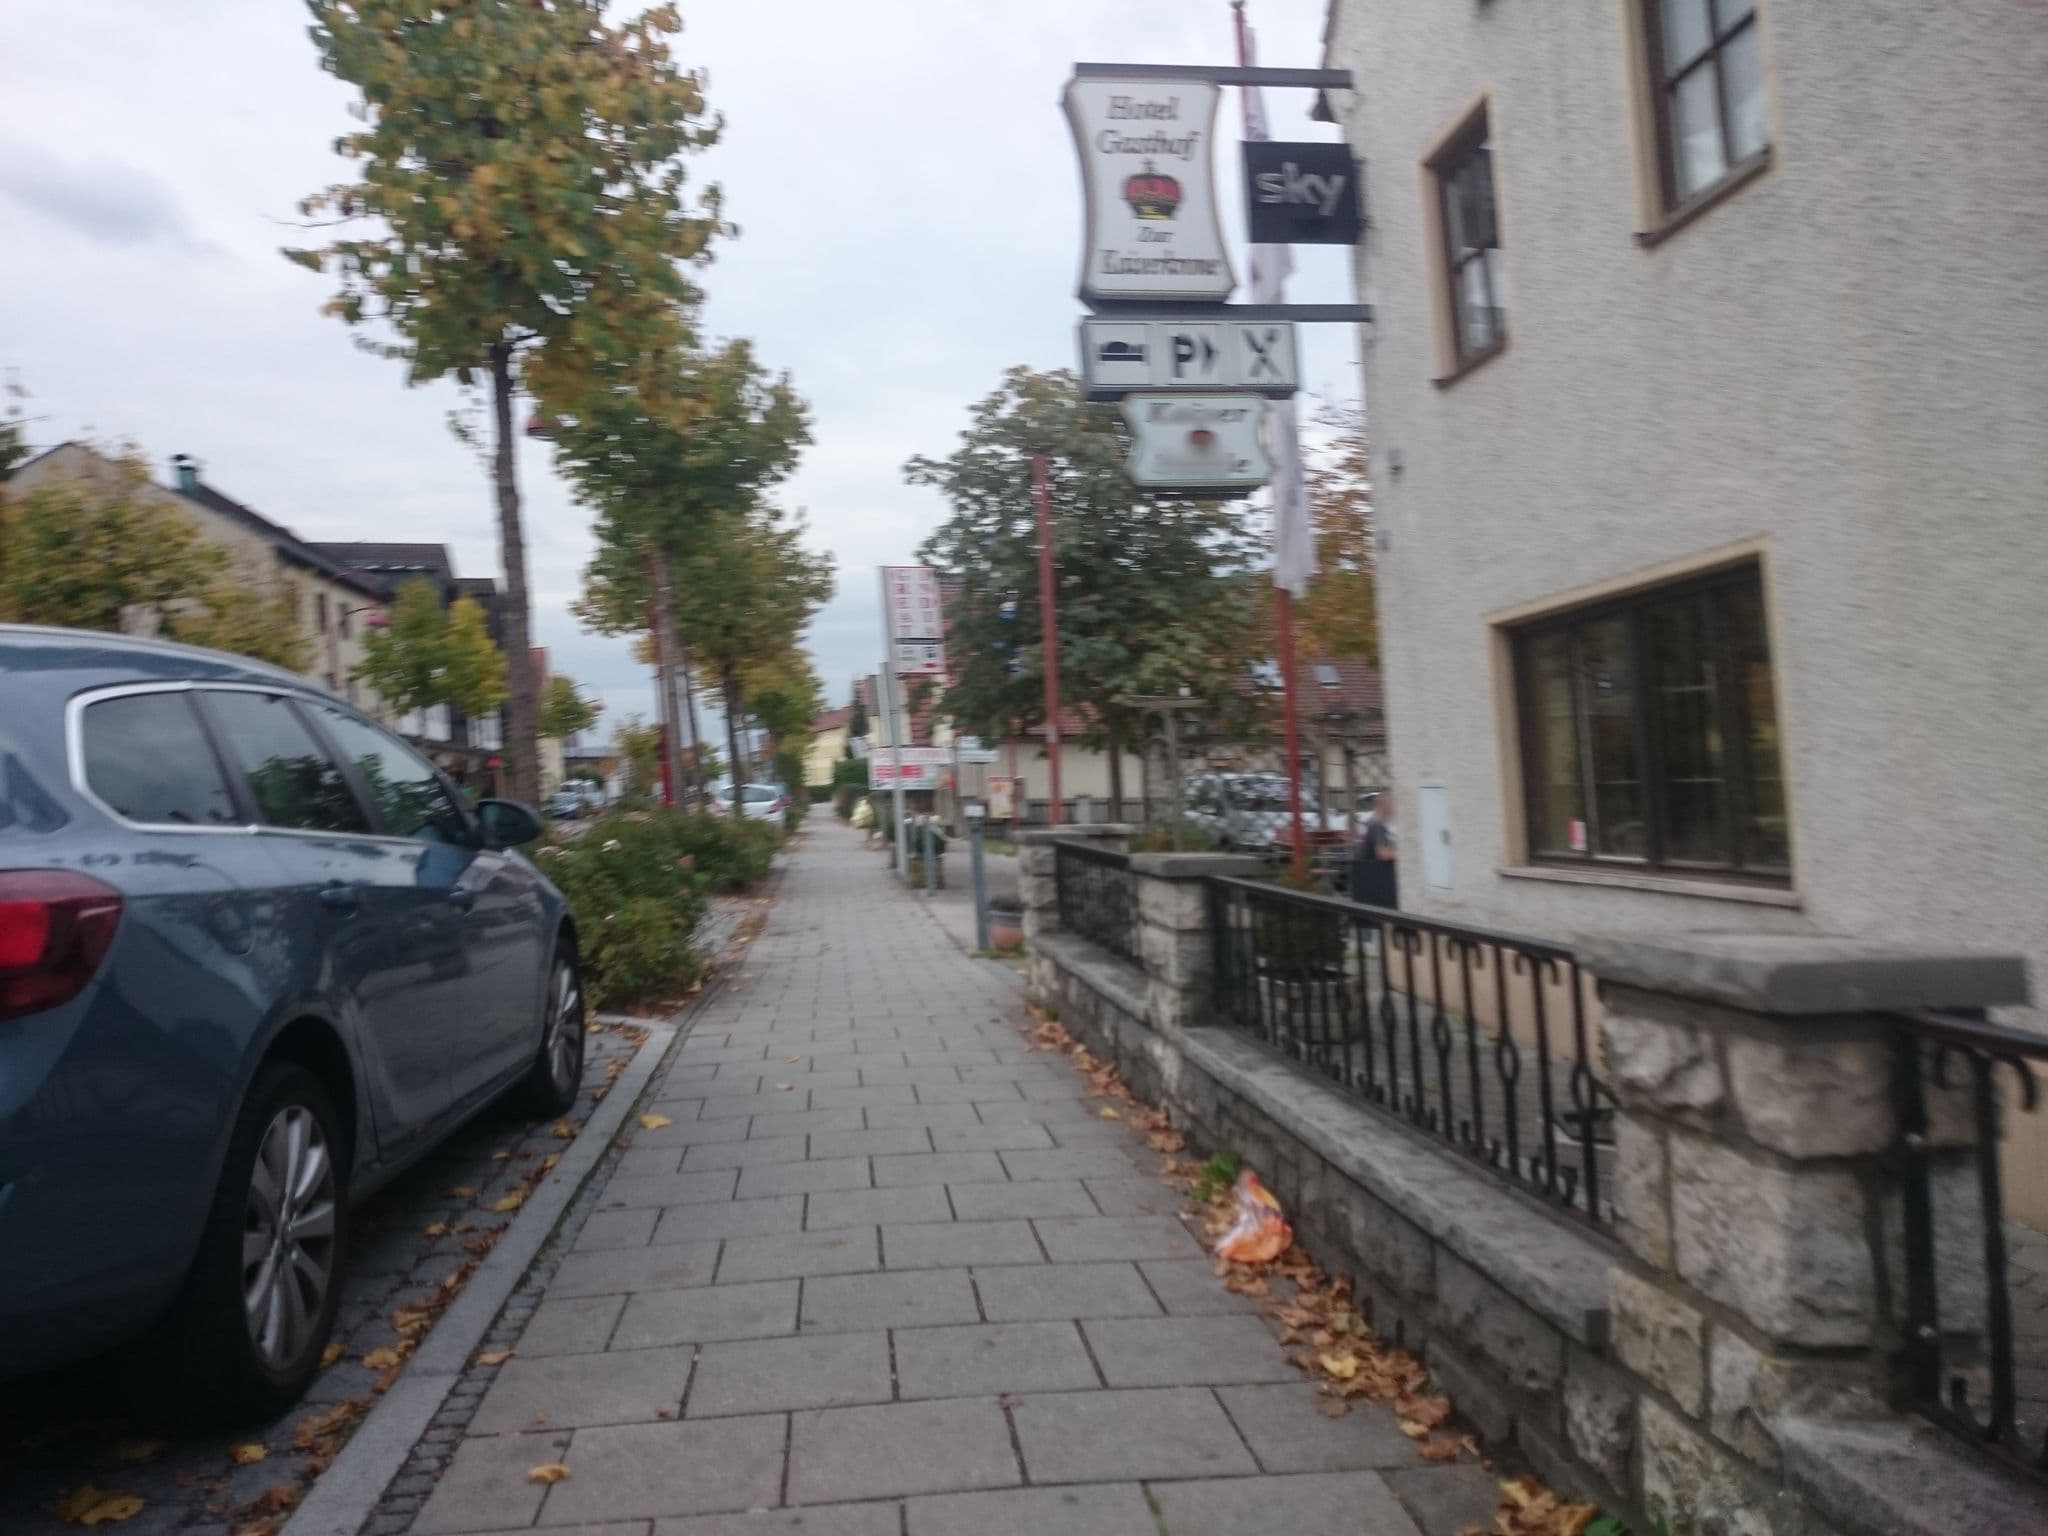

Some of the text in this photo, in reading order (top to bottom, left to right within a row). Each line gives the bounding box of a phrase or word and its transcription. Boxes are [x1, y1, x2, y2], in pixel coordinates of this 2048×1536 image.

[1107, 95, 1180, 120] Hotel
[1096, 129, 1201, 162] Gasthof
[1255, 161, 1346, 217] sky
[1171, 335, 1195, 378] P
